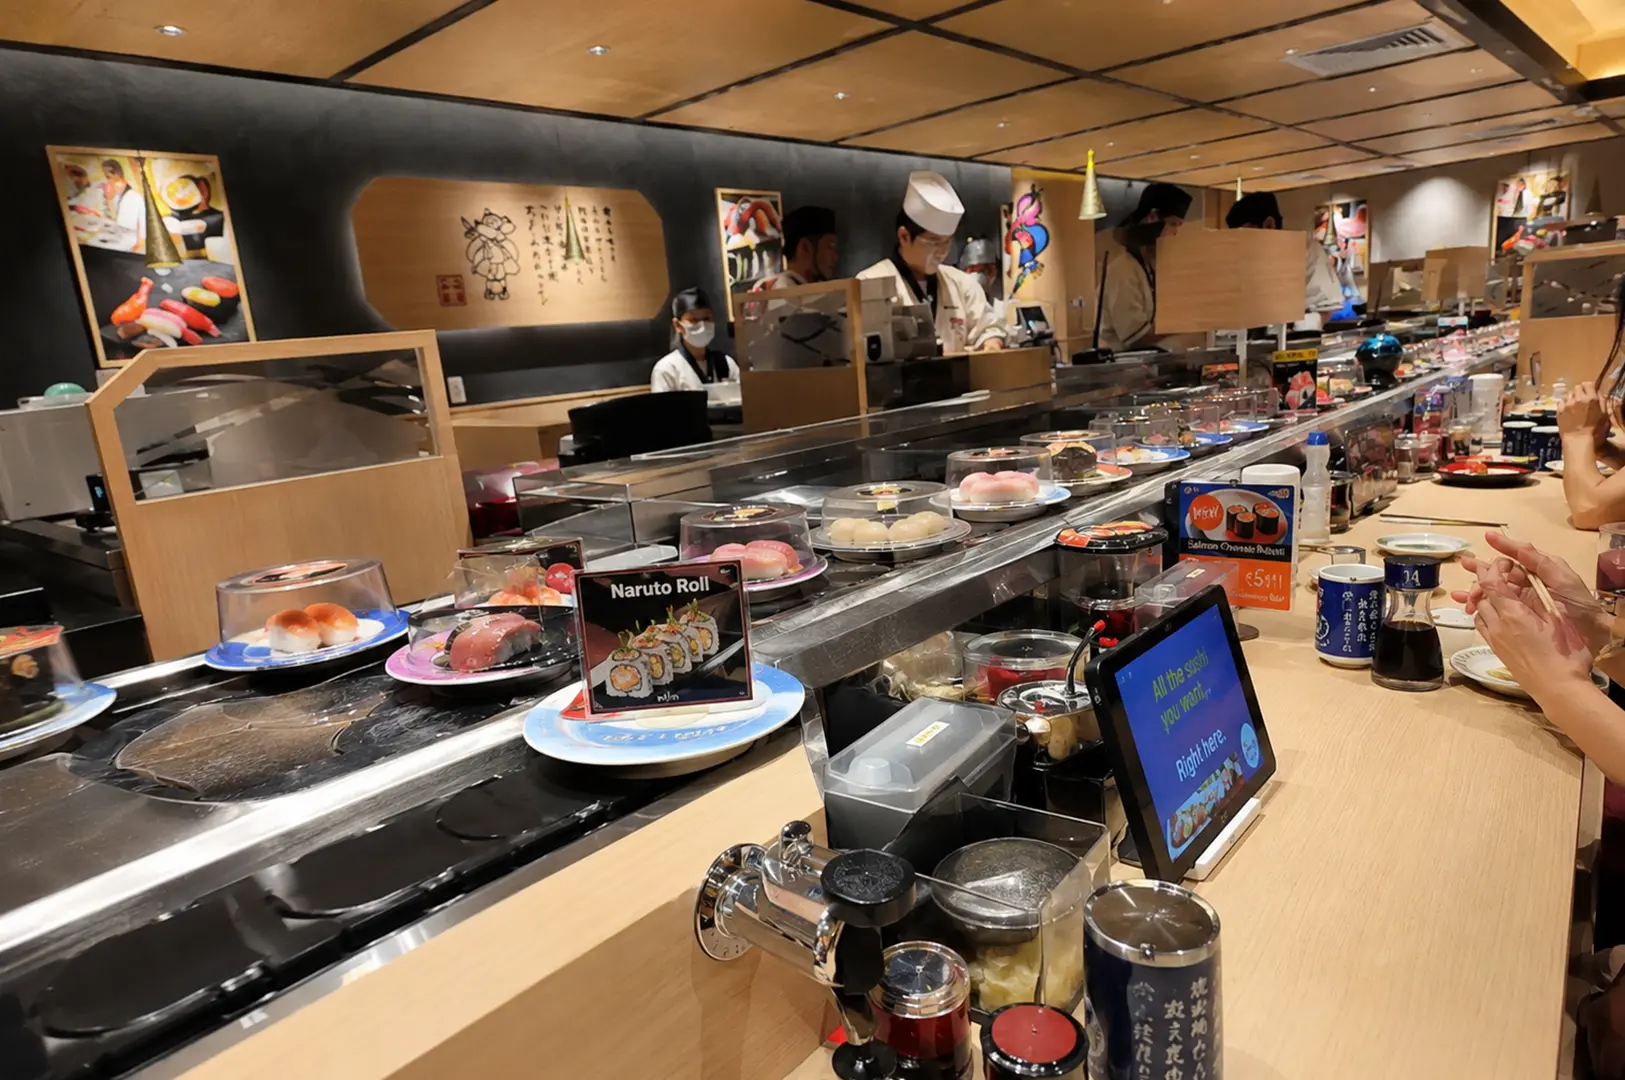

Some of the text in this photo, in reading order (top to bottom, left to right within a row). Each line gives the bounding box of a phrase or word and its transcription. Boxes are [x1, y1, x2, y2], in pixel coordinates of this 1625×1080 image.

[610, 575, 710, 599] Naruto Roll
[1152, 674, 1169, 703] All
[1166, 668, 1185, 691] the
[1161, 704, 1181, 735] you
[1175, 743, 1204, 782] Right
